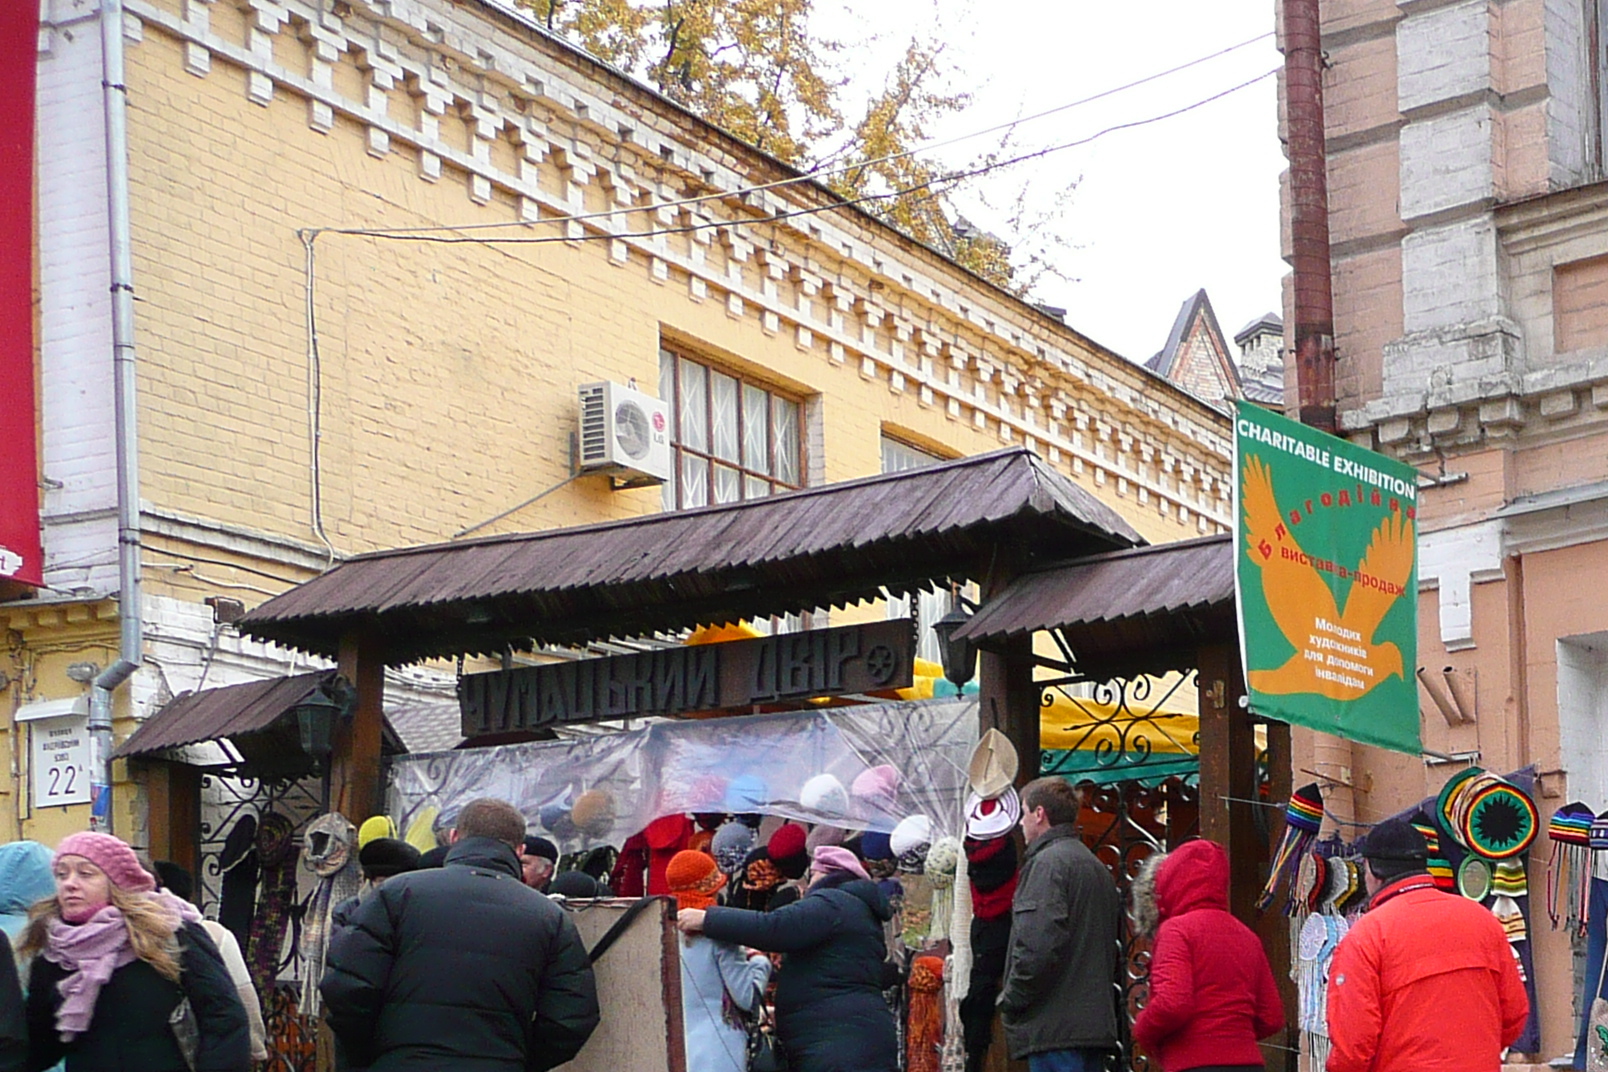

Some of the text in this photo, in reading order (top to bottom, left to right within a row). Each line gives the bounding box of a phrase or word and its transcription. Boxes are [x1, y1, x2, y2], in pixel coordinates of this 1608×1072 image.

[653, 432, 664, 445] LG
[1237, 419, 1415, 500] CHARITABLE EXHIBITION
[1258, 483, 1416, 560] Благодійна
[749, 626, 862, 703] ДВІР
[1304, 649, 1324, 662] для
[1315, 666, 1365, 689] інвалідам
